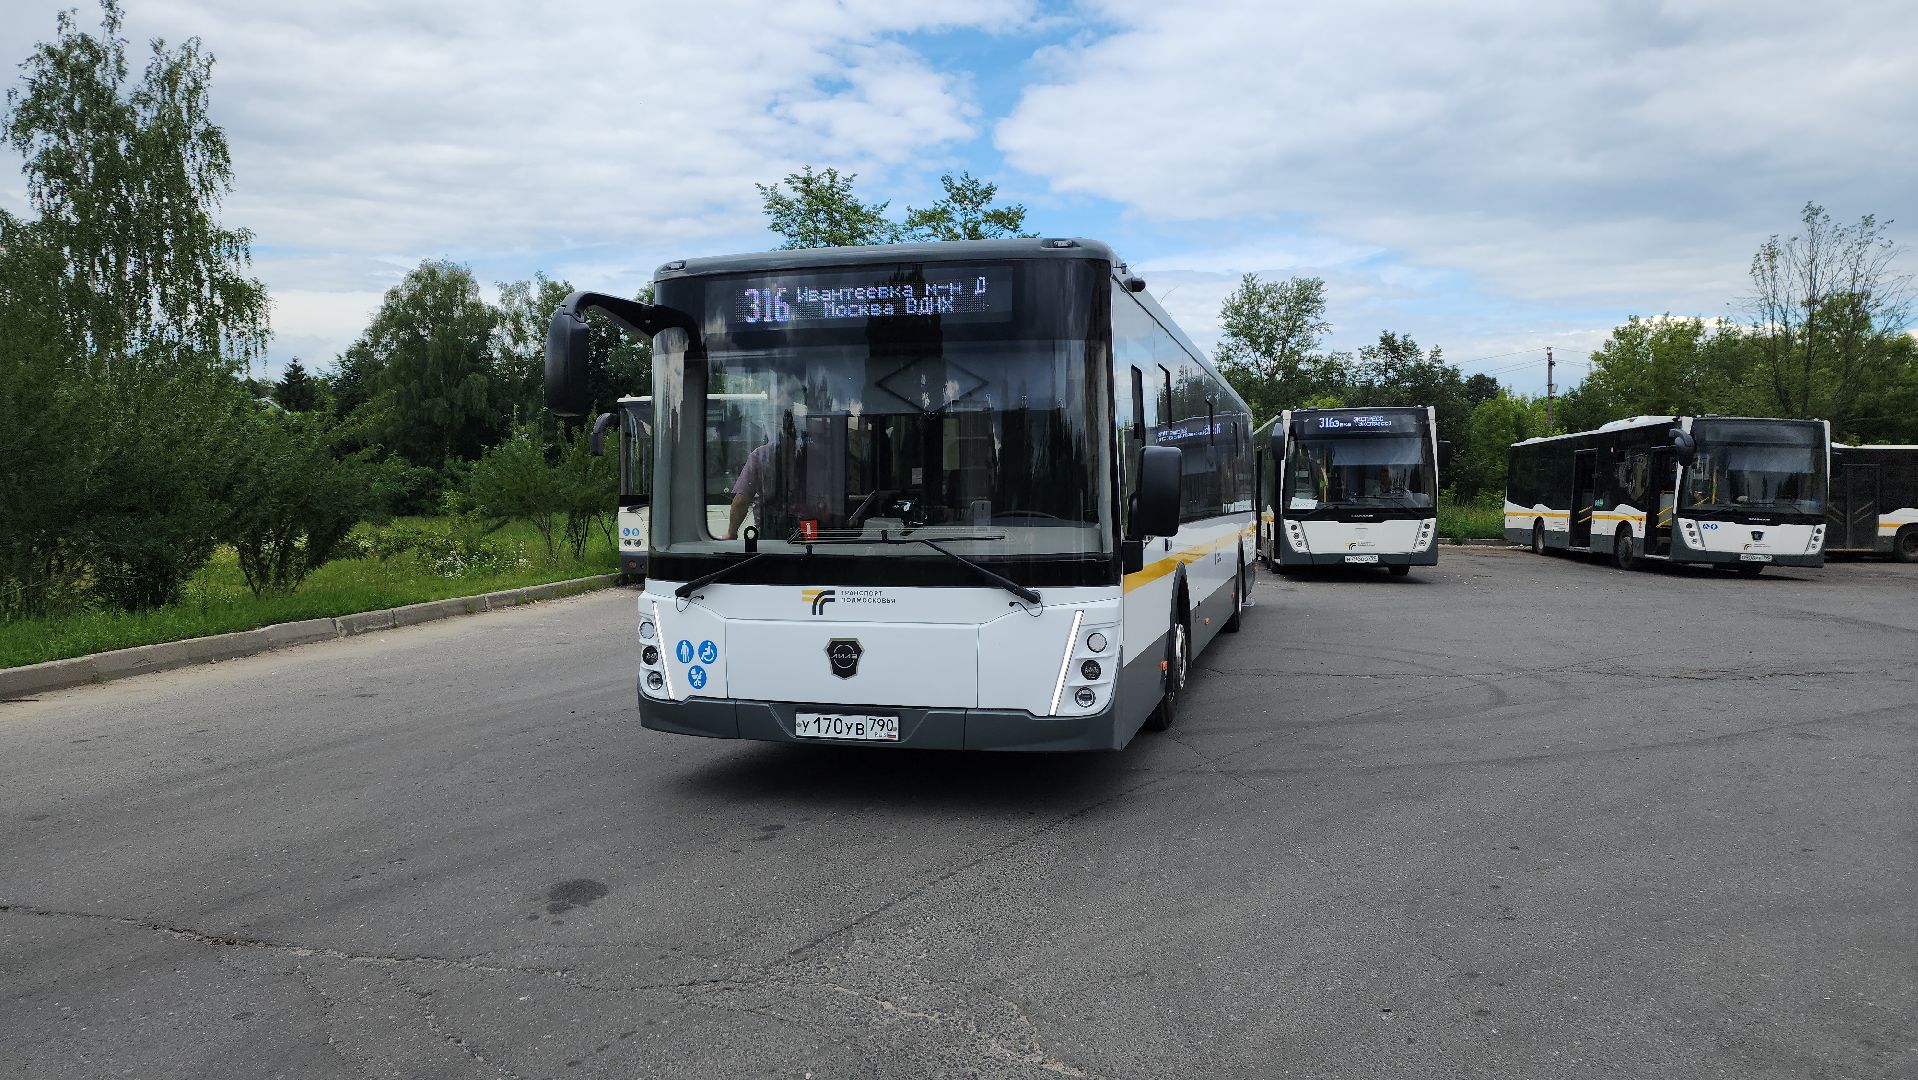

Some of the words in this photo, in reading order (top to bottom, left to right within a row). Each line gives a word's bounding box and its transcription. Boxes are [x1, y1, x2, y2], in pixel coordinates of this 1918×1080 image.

[797, 285, 913, 303] Ивантеевка
[744, 287, 790, 323] 316
[824, 301, 894, 319] Москва
[905, 295, 954, 316] ВДНХ
[868, 718, 895, 732] 790
